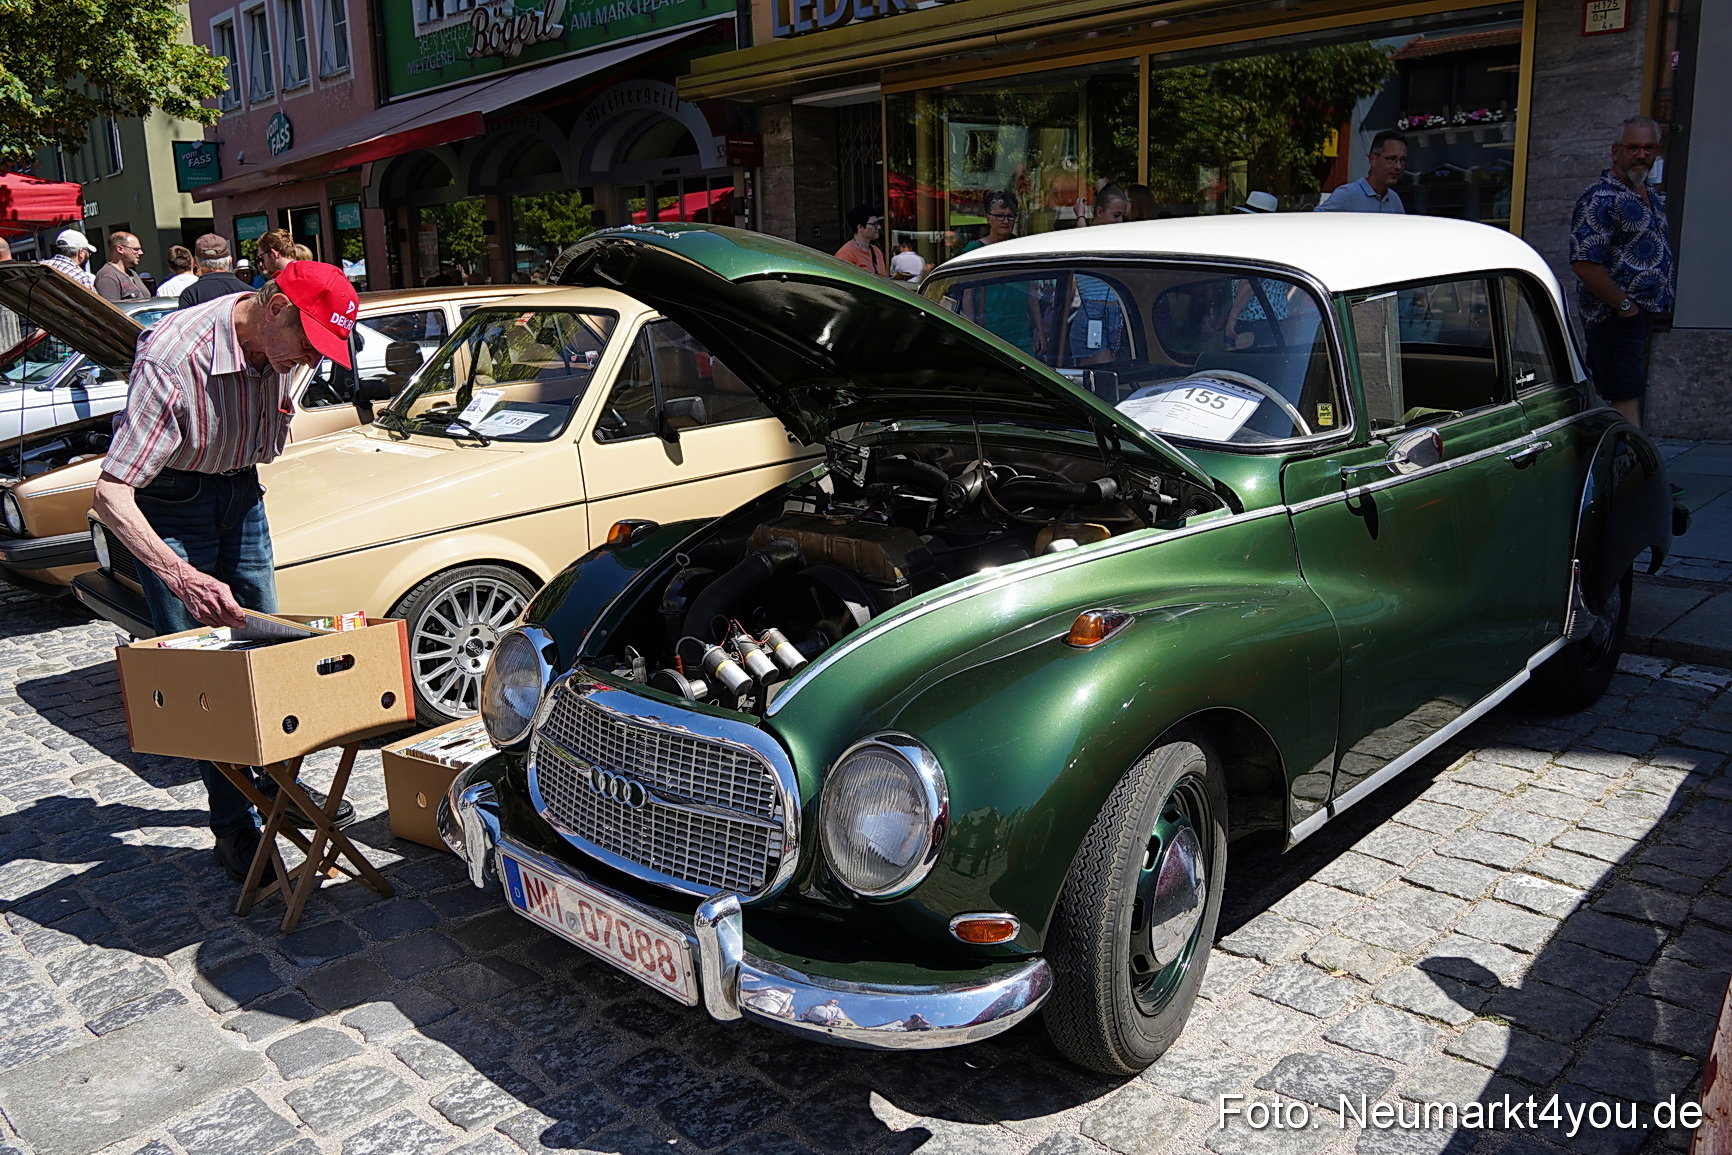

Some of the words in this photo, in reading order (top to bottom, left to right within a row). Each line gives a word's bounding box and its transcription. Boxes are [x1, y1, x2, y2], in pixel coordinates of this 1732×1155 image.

[466, 0, 564, 58] Bögerl
[570, 10, 592, 32] AM
[408, 49, 456, 76] METZGEREI
[265, 117, 279, 140] vom
[272, 123, 291, 157] FASS
[181, 151, 198, 160] vom
[188, 153, 212, 168] FASS
[1184, 387, 1229, 410] 155
[505, 417, 528, 426] 318
[514, 886, 521, 899] D
[522, 871, 564, 925] NM
[578, 900, 677, 983] 07088
